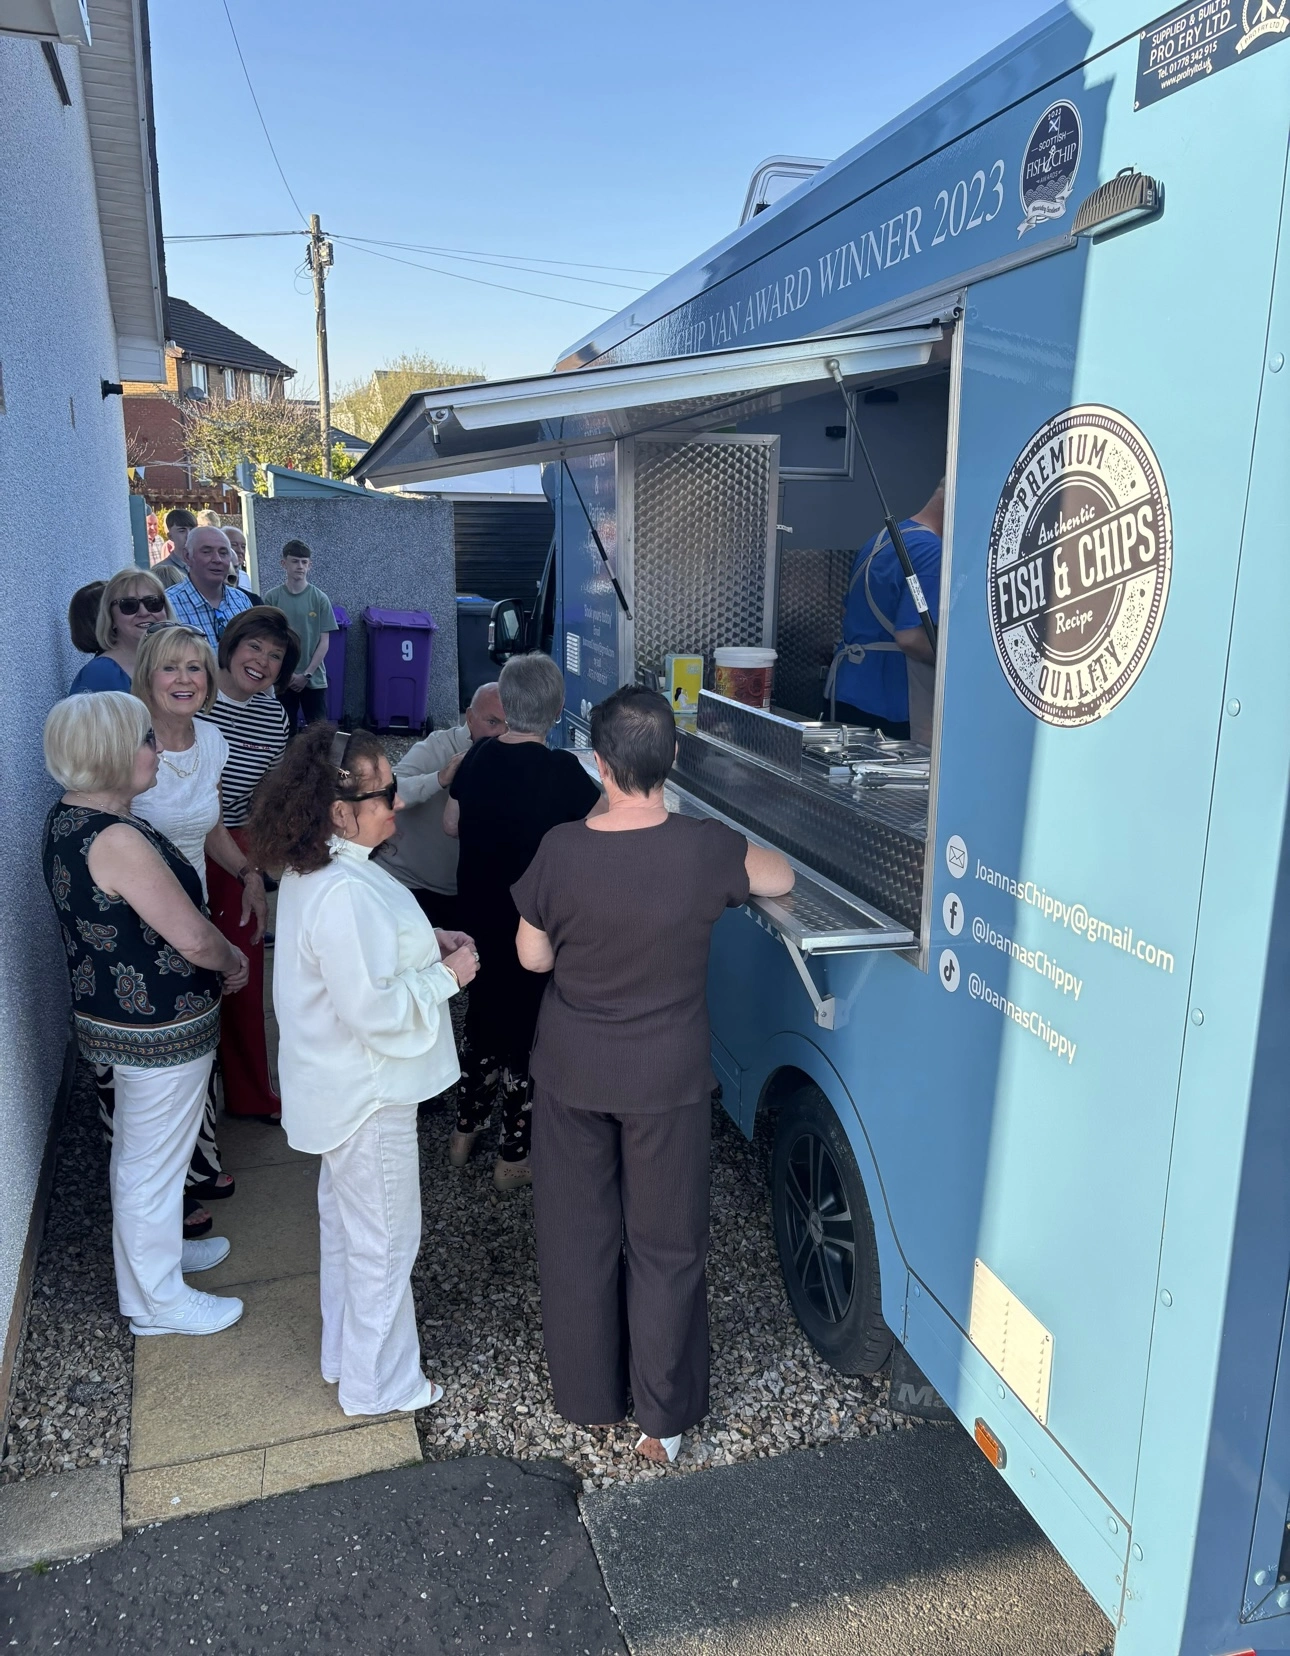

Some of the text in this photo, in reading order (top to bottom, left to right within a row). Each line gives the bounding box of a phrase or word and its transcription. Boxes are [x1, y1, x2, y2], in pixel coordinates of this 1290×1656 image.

[1149, 9, 1231, 67] PRO FRY LTD
[1152, 18, 1186, 47] SUPPLIED
[1189, 13, 1196, 26] &
[1198, 1, 1219, 21] BUILT
[1257, 23, 1268, 33] FRY
[1269, 21, 1280, 29] LTD
[1158, 41, 1218, 79] Tel. 01778 342 915
[1026, 156, 1047, 179] FISH
[1051, 142, 1077, 167] CHIP
[1038, 130, 1067, 151] SCOTTISH
[710, 301, 741, 347] VAN
[743, 266, 812, 334] AWARD
[818, 205, 922, 298] WINNER
[931, 159, 1006, 248] 2023
[1017, 433, 1108, 513] PREMIUM
[1037, 503, 1096, 545] Authentic
[998, 557, 1047, 624] FISH
[1053, 546, 1070, 599] &
[1079, 504, 1156, 588] CHIPS
[1055, 608, 1094, 635] Recipe
[401, 640, 413, 661] 9
[1037, 636, 1123, 700] QUALITY
[975, 859, 1175, 974] JoannasChippy@gmail.com
[972, 916, 1083, 1001] @JoannasChippy
[968, 972, 1077, 1064] @JoannasChippy
